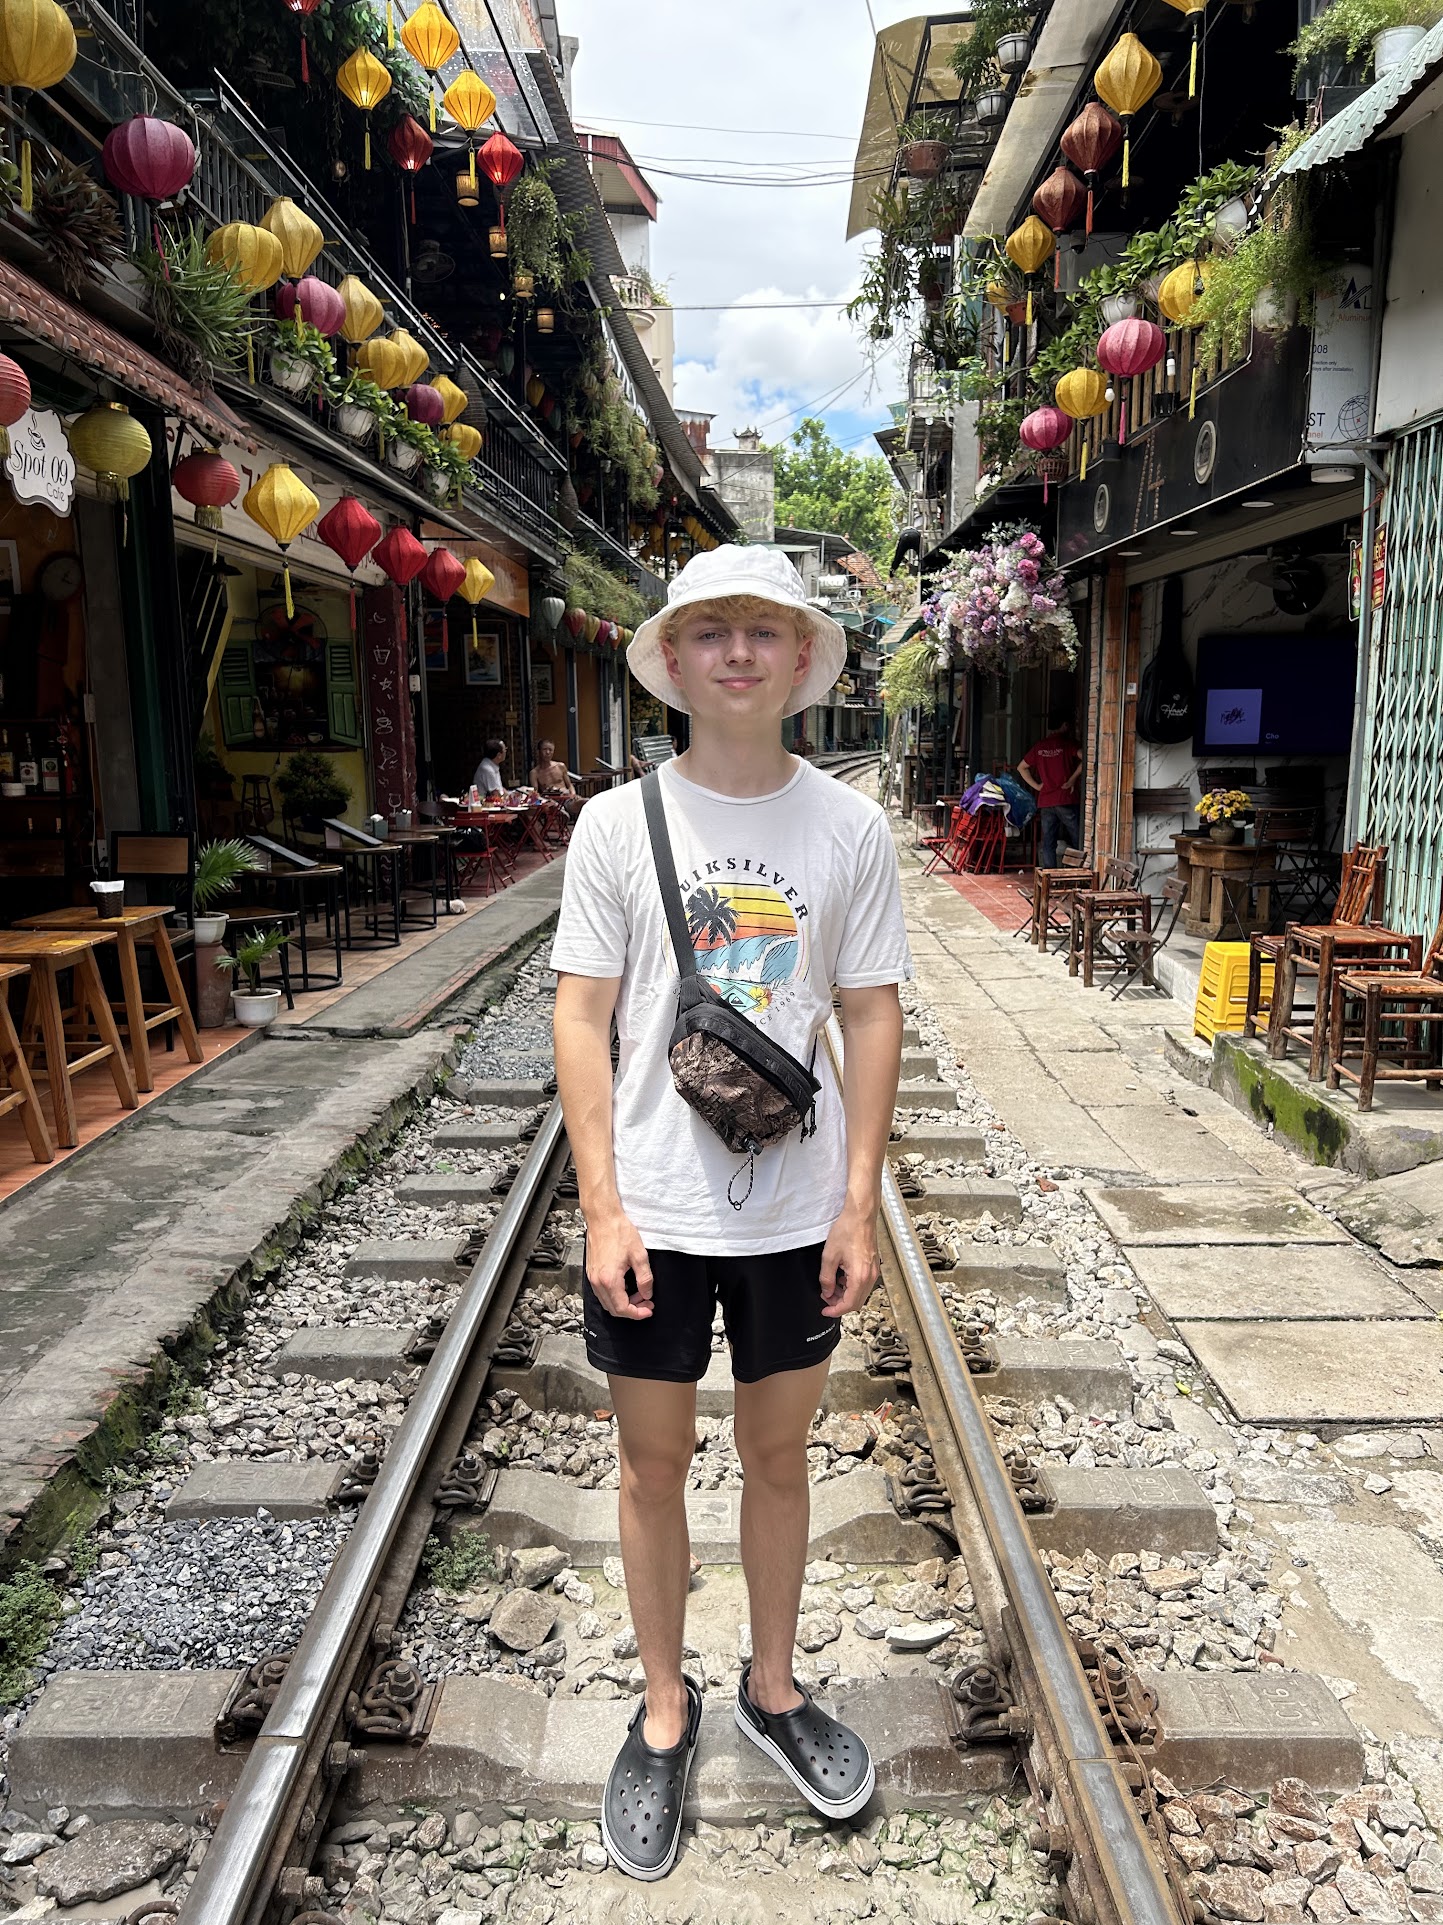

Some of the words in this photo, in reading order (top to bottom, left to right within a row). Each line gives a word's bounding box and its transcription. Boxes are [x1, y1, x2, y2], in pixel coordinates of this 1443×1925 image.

[9, 439, 47, 480] Spot
[51, 456, 68, 487] 09
[680, 857, 809, 921] UIKSILVER
[775, 991, 796, 1013] 1969
